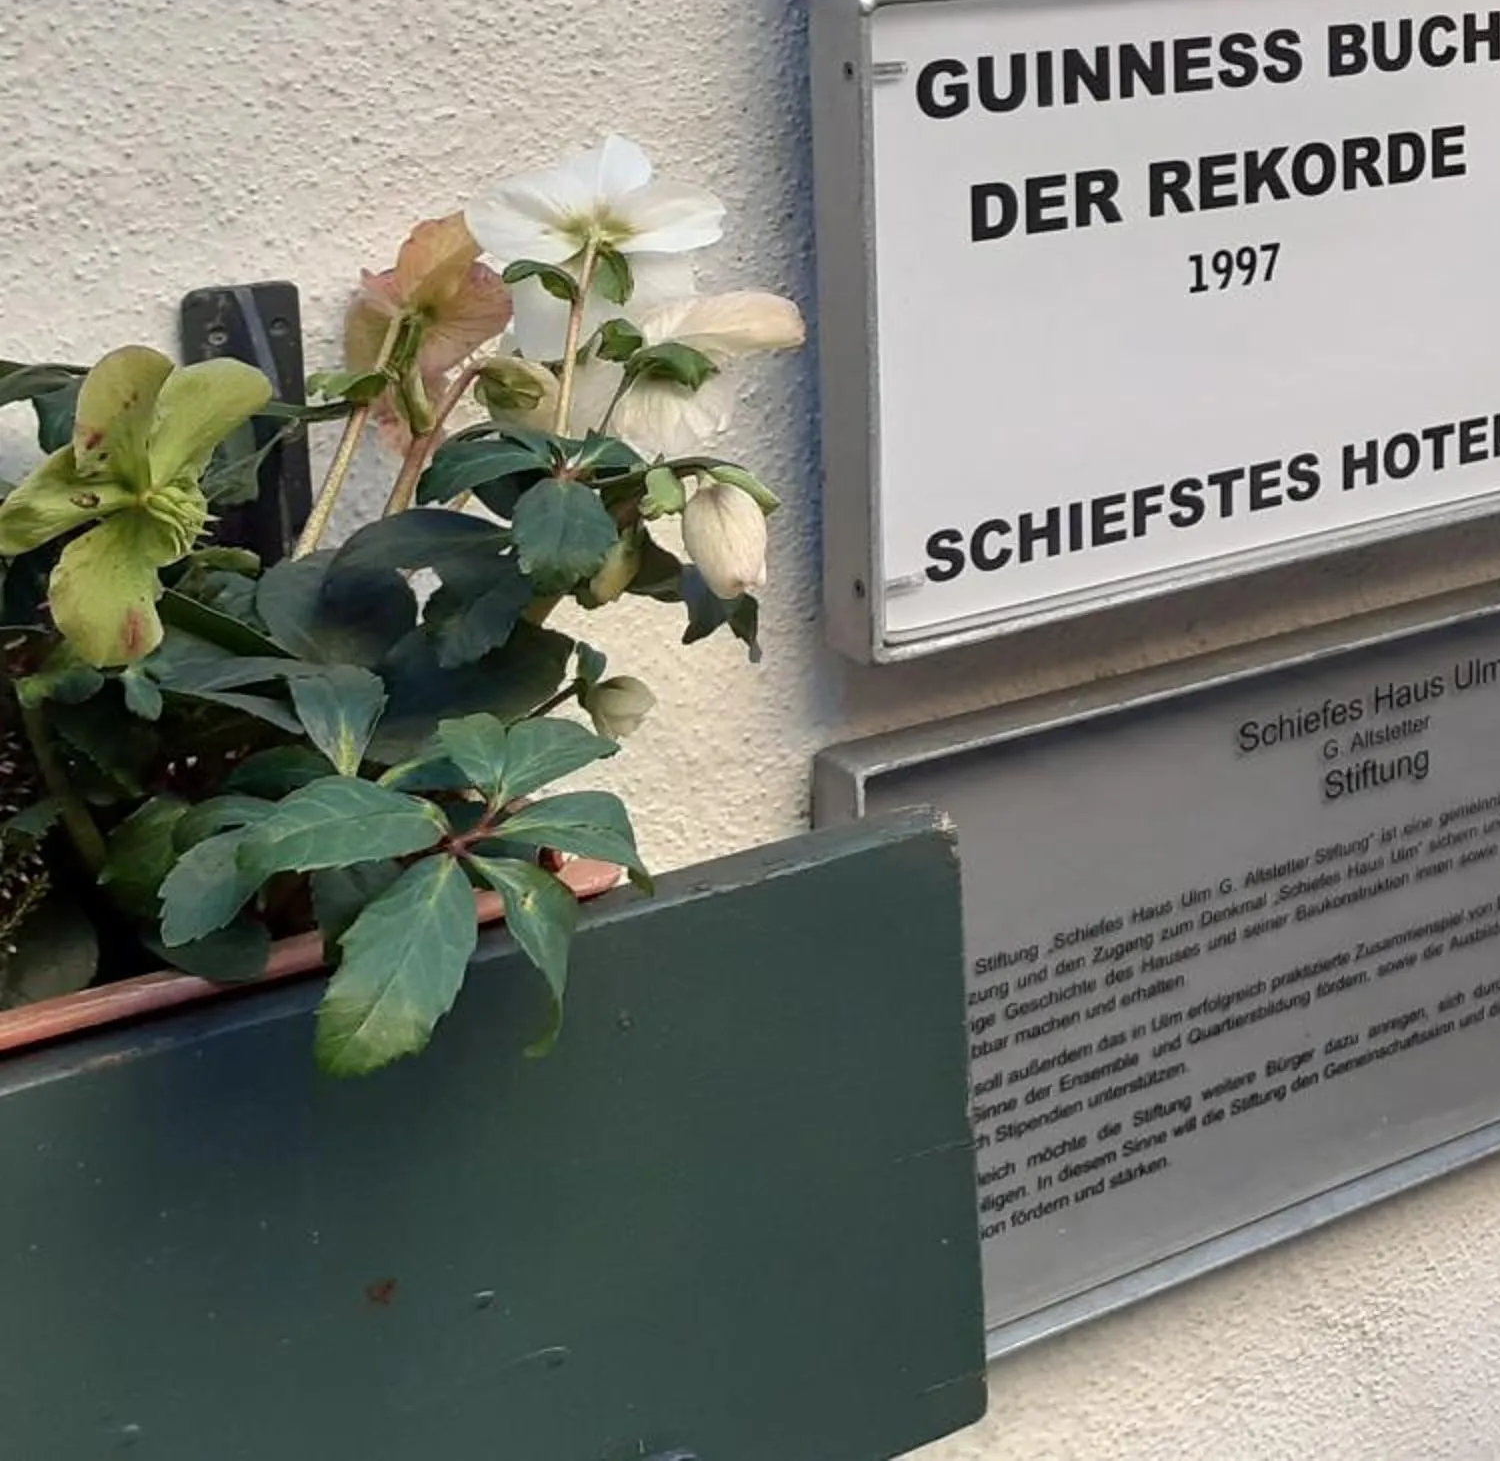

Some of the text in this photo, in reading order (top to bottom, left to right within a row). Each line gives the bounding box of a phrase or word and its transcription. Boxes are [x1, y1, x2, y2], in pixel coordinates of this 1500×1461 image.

[916, 11, 1500, 119] GUINNESS BUCH
[971, 125, 1465, 241] DER REKORDE
[1189, 242, 1280, 293] 1997
[925, 453, 1320, 583] SCHIEFSTES
[1237, 698, 1363, 752] Schiefes
[1374, 676, 1444, 714] Haus
[1323, 715, 1430, 760] G. Altstetter
[1325, 750, 1428, 800] Stiftung
